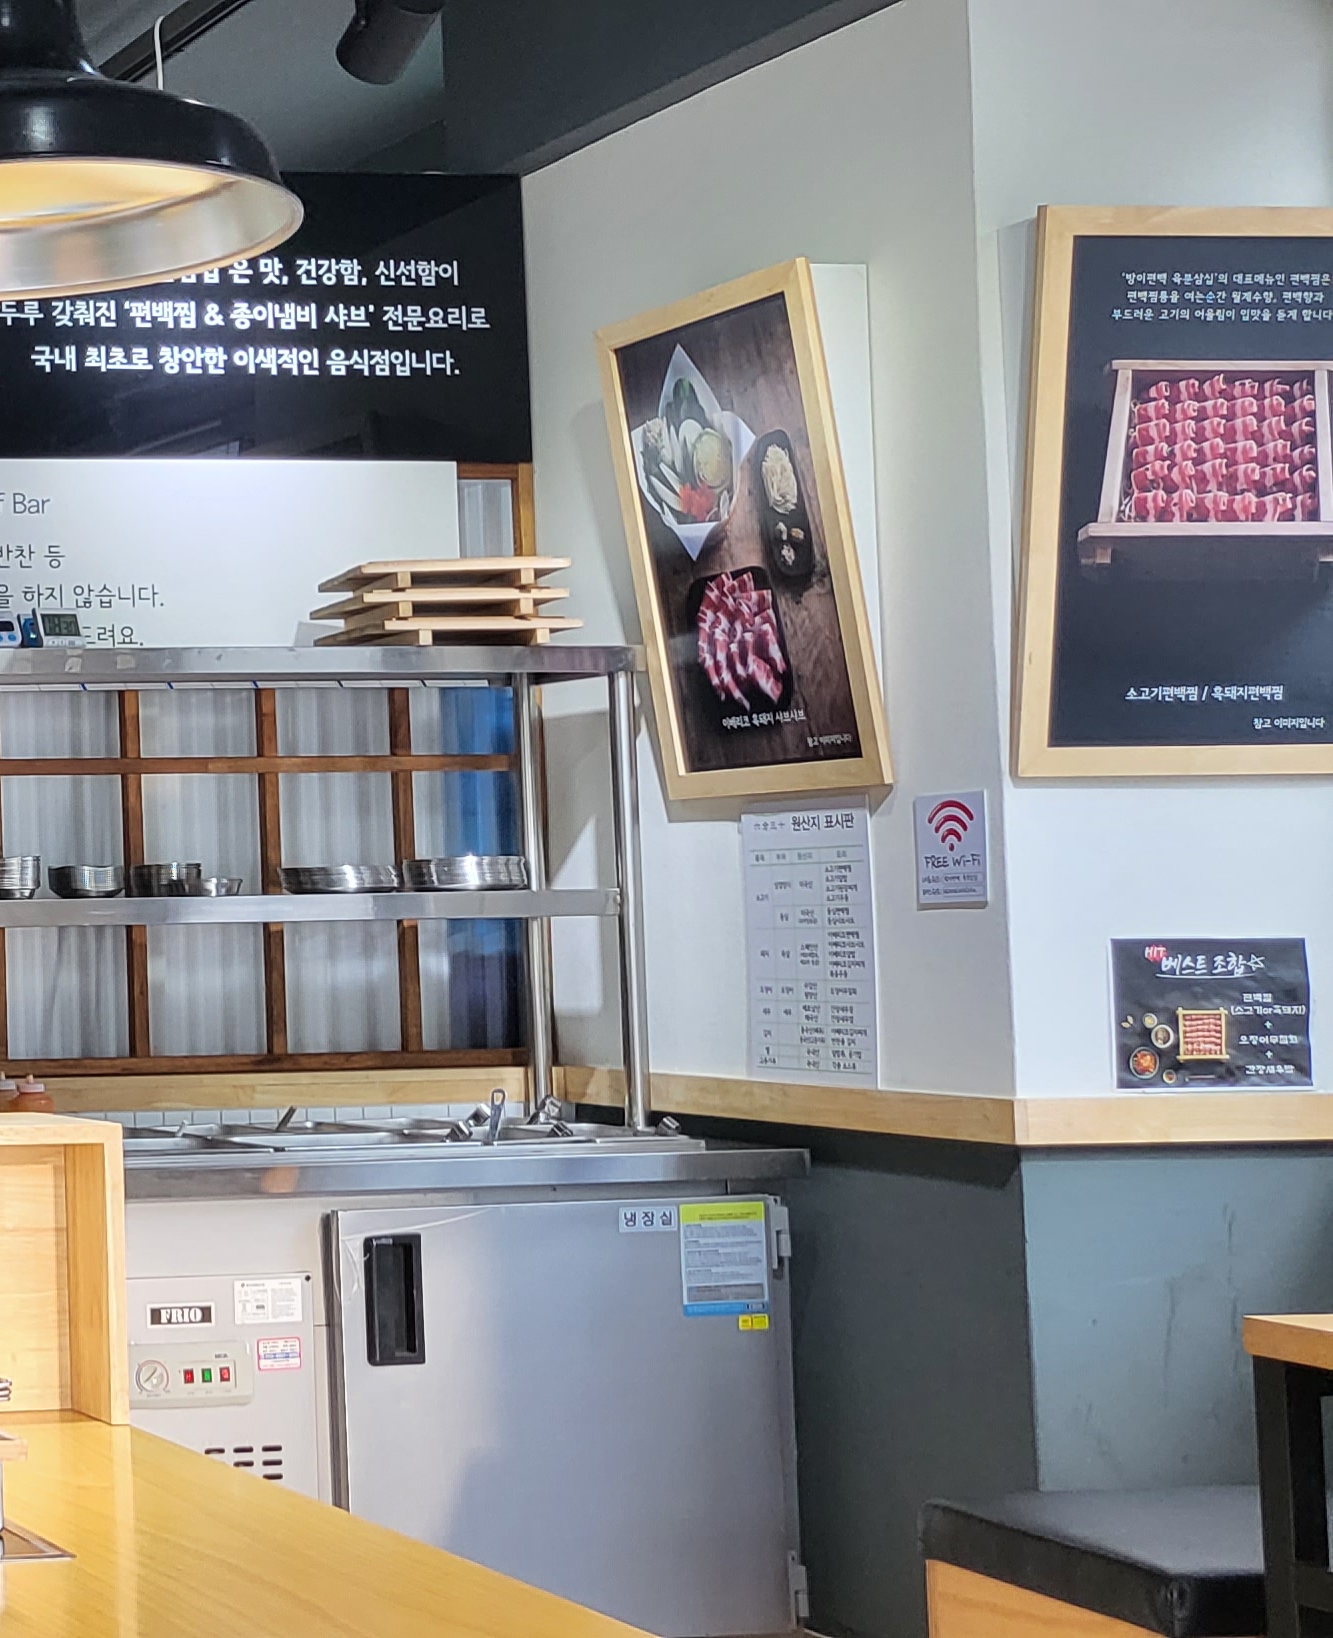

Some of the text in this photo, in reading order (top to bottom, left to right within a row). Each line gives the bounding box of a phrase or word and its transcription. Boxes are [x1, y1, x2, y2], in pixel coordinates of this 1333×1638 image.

[258, 258, 289, 285] 맛,
[296, 258, 368, 286] 건강함,
[374, 259, 460, 286] 신선함이
[51, 300, 118, 327] 갖춰진
[124, 300, 197, 328] ‘편백찜
[204, 303, 225, 326] &
[229, 302, 318, 329] 종이냄비
[324, 303, 375, 329] 샤브’
[382, 304, 491, 331] 전문요리로
[1158, 308, 1190, 321] 고기의
[31, 345, 461, 376] 국내 최초로 창안한 이색적인 음식점입니다.
[12, 492, 51, 515] Bar
[43, 544, 66, 569] 등
[21, 584, 65, 609] 하지
[73, 584, 165, 609] 않습니다.
[1125, 685, 1199, 701] 소고기편백찜
[1211, 684, 1284, 701] 흑돼지편백찜
[791, 812, 855, 832] 원산지 표시판
[924, 853, 981, 869] FREE Wi-Fi
[1144, 946, 1167, 959] HIT
[1161, 952, 1248, 976] 베스트 조합
[623, 1210, 673, 1228] 냉장실
[160, 1307, 204, 1324] FRIO
